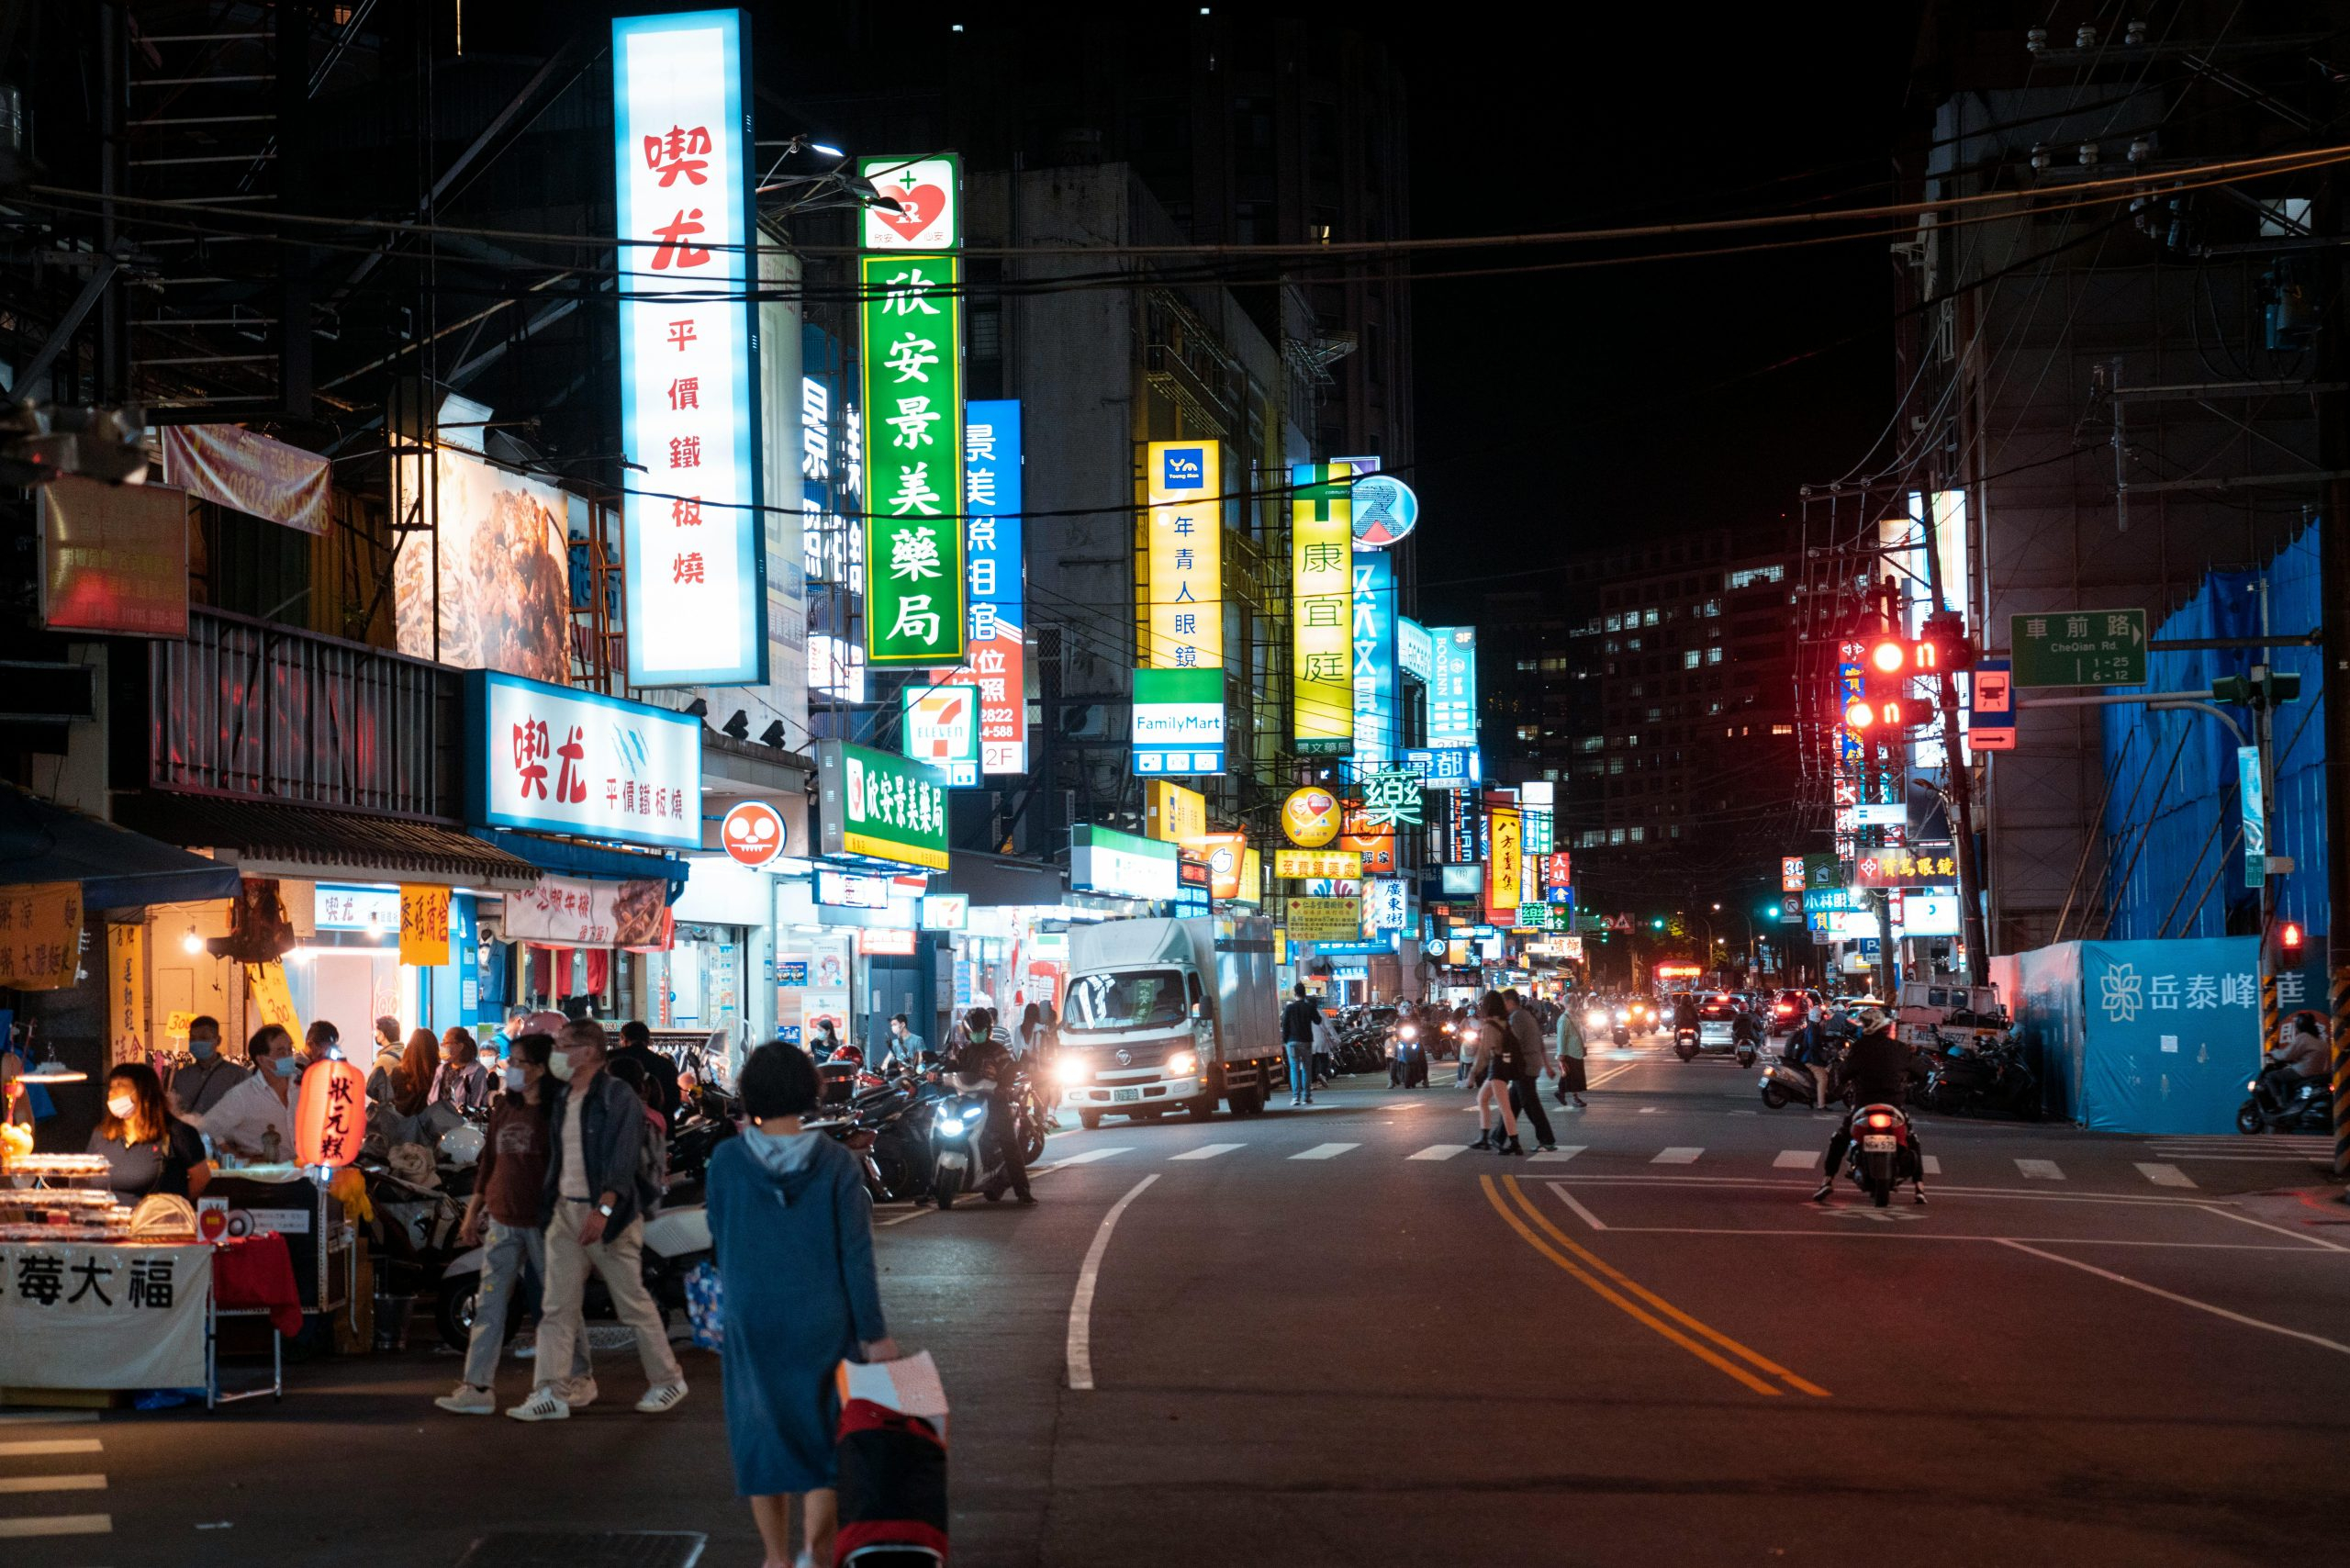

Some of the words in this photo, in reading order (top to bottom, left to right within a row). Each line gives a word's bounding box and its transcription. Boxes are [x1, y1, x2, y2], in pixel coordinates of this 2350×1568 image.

[667, 319, 705, 586] 平價鐵板燒
[881, 268, 943, 646] 欣安景美藥局
[1174, 516, 1197, 668] 年青人眼鏡
[1302, 542, 1345, 682] 康宜庭
[1456, 633, 1472, 644] 3F
[2025, 614, 2131, 640] 車前路
[2051, 643, 2095, 653] CheQian
[2101, 642, 2119, 651] Rd.
[1436, 637, 1448, 697] BOOKINN
[1137, 716, 1220, 733] FamilyMart
[513, 713, 587, 804] 喫尤
[985, 748, 1013, 766] 2F
[1297, 744, 1351, 754] 景文藥局
[606, 778, 683, 820] 平價鐵板燒
[867, 768, 943, 836] 欣安景美藥局
[1365, 768, 1423, 826] 藥
[1497, 823, 1516, 890] 八方雲集
[1882, 857, 1955, 877] 寶島眼鏡
[1384, 883, 1403, 925] 廣東粥
[1522, 903, 1544, 926] 藥
[1867, 940, 1876, 951] P
[320, 1077, 352, 1160] 狀元糕
[0, 1255, 174, 1309] 莓大福
